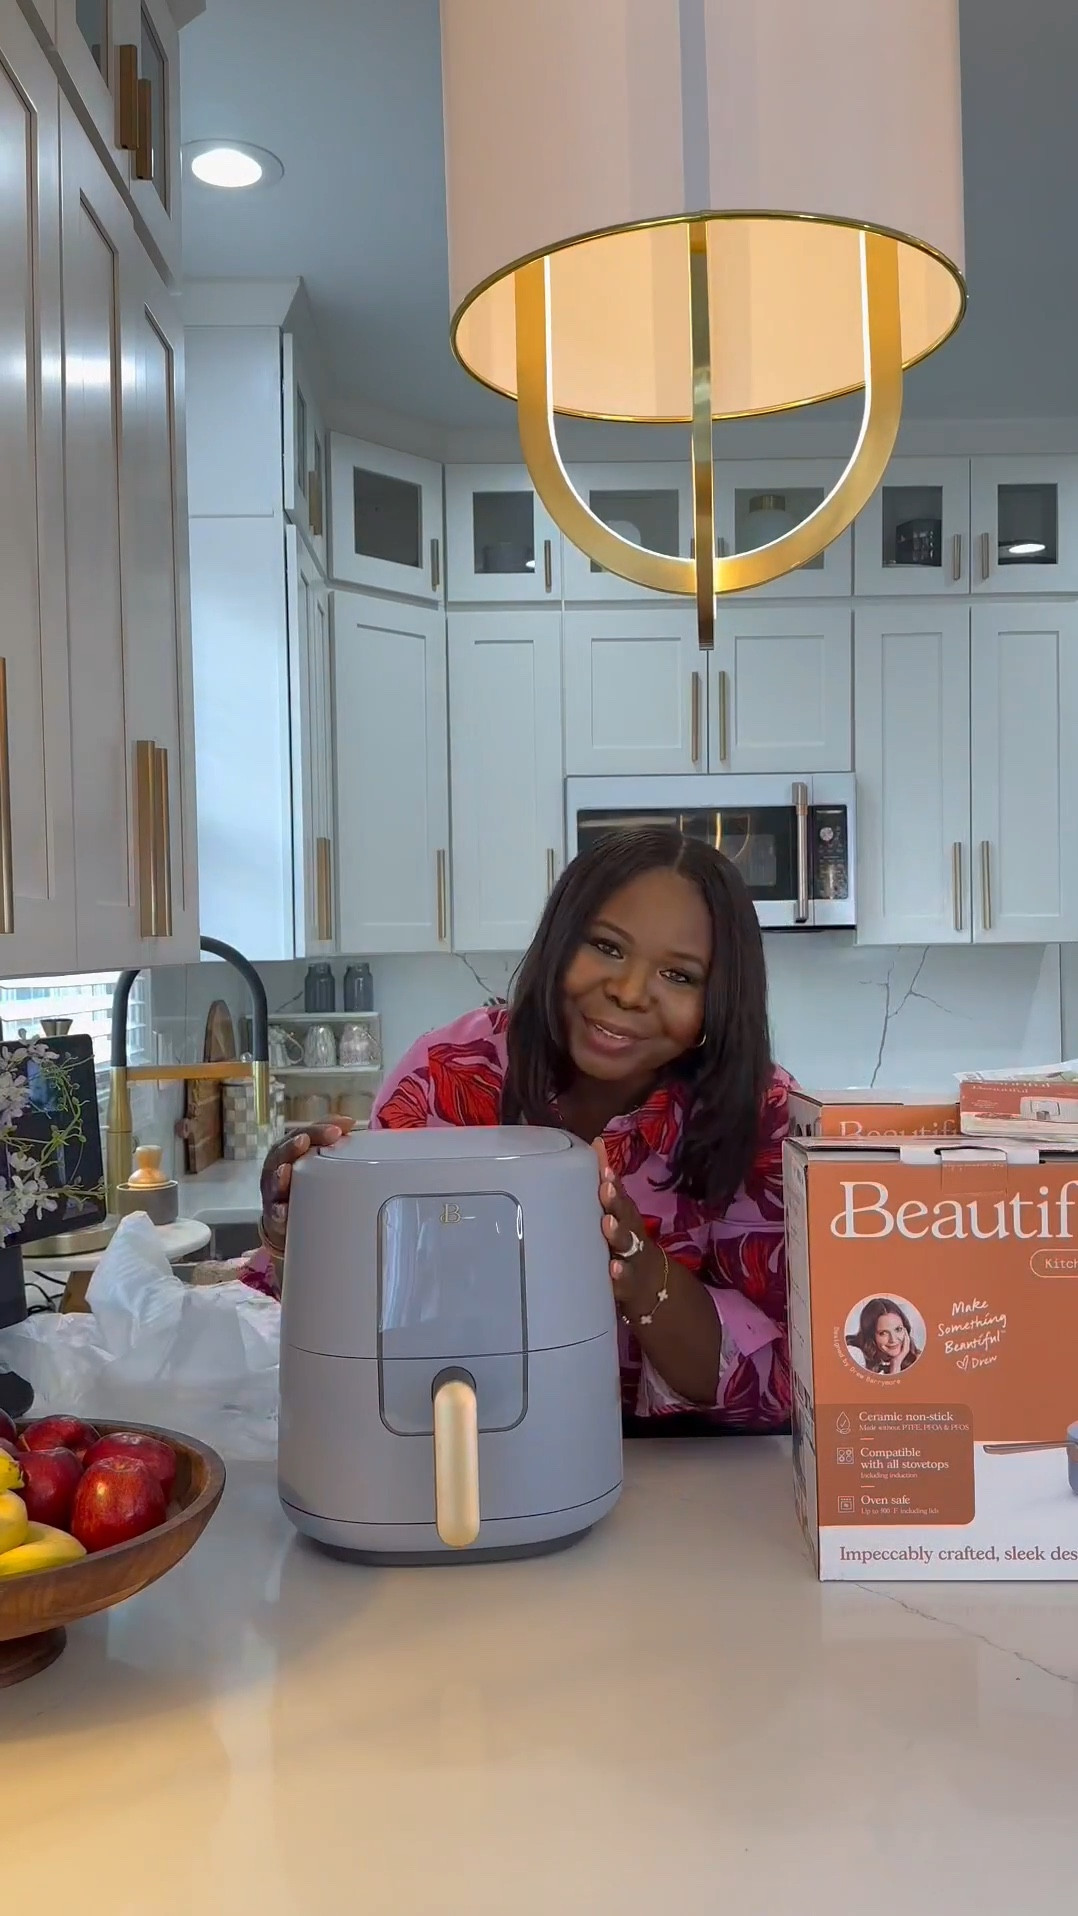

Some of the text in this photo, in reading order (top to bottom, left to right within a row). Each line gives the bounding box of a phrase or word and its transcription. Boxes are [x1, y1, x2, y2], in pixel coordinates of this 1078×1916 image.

[830, 1180, 1078, 1239] Beautif
[952, 1298, 988, 1316] Make
[938, 1312, 1006, 1336] Something
[971, 1355, 997, 1369] Drew
[850, 1366, 865, 1379] Drew
[865, 1377, 901, 1387] Barrymore
[859, 1411, 954, 1422] Ceramic non-stick
[860, 1447, 921, 1459] Compatible
[860, 1460, 949, 1471] with all stovetops
[860, 1495, 911, 1505] Oven safe
[839, 1546, 1078, 1564] Impeccably crafted, sleek des
